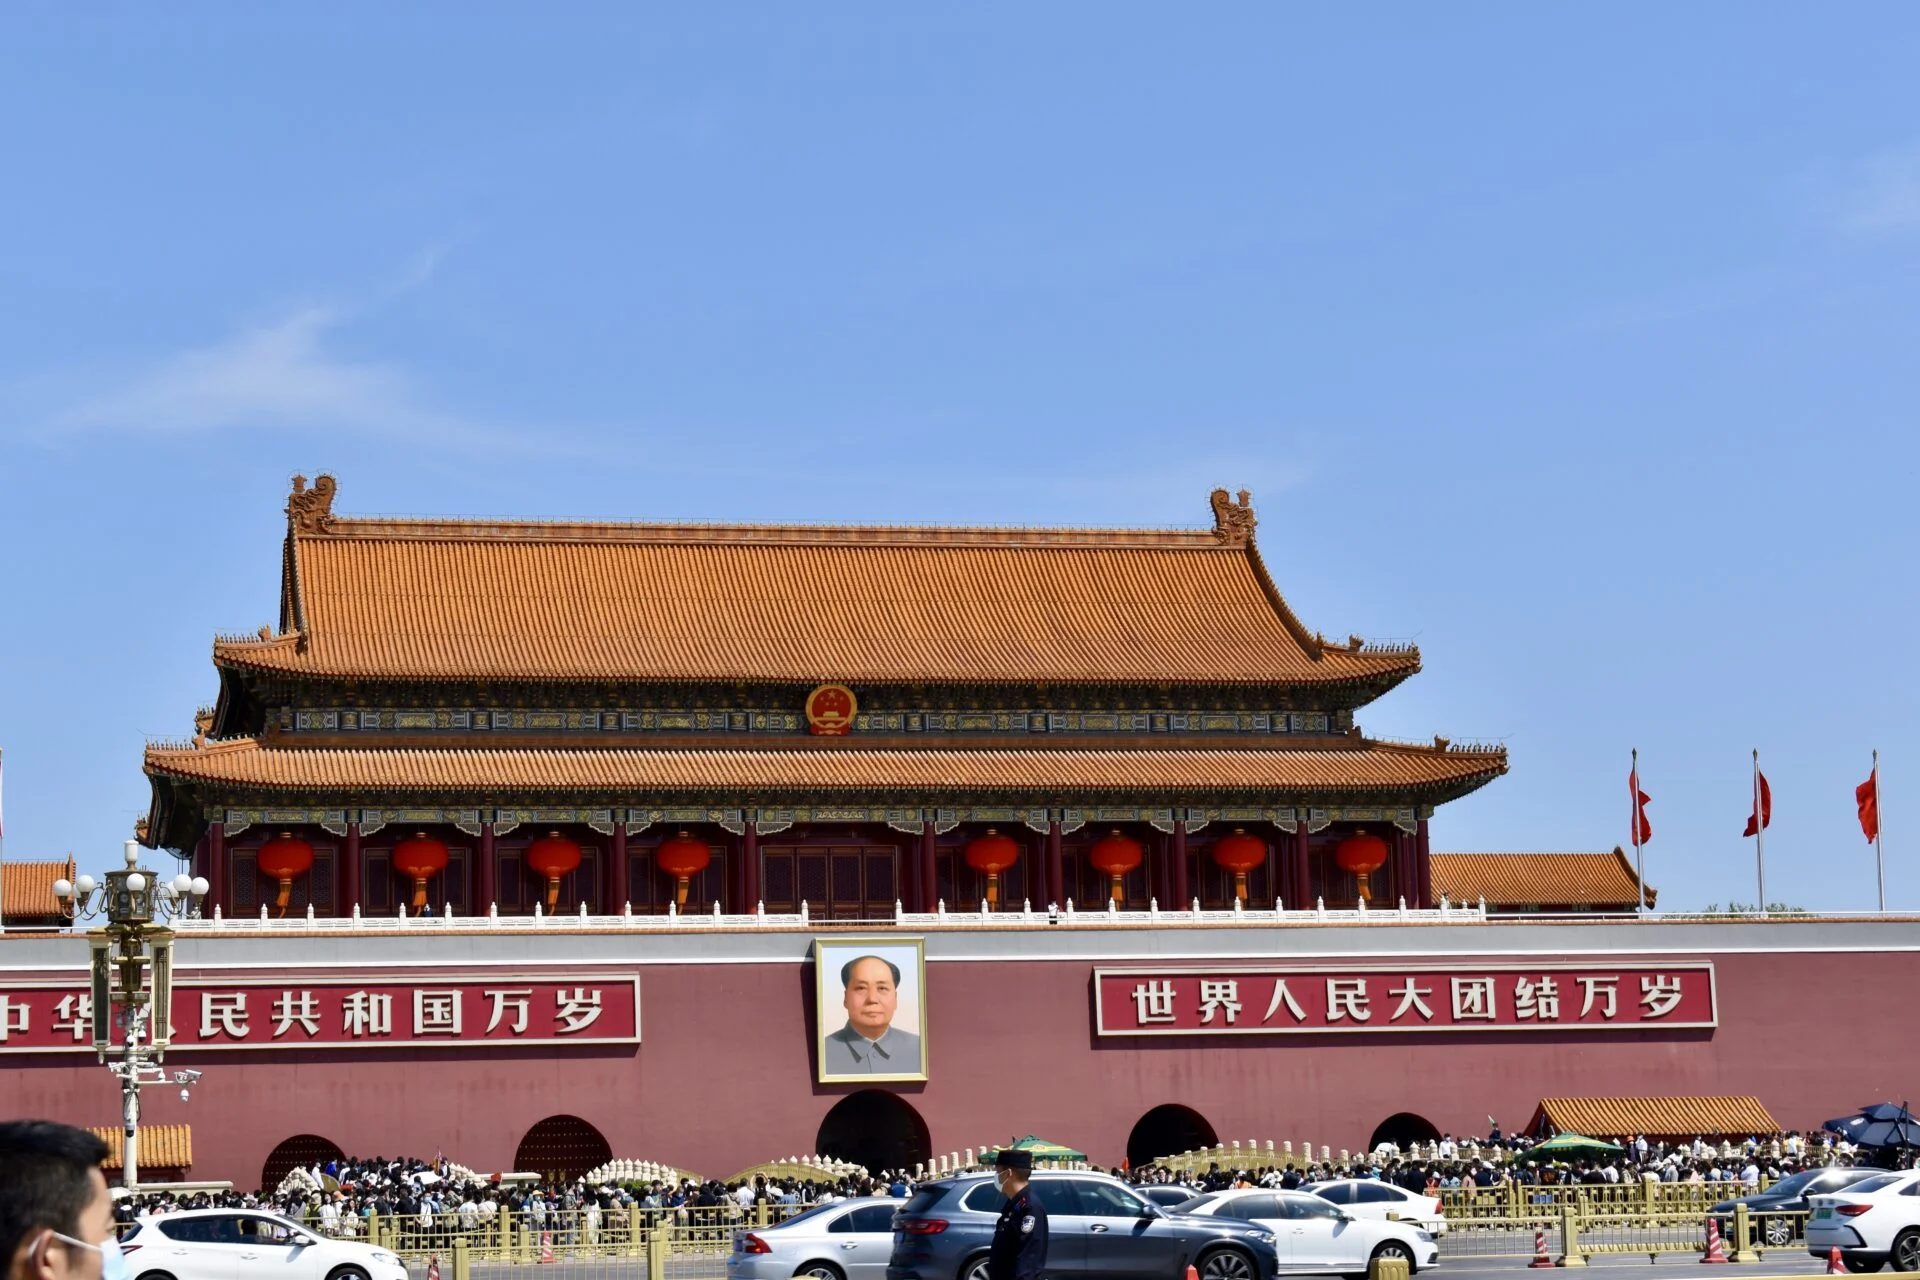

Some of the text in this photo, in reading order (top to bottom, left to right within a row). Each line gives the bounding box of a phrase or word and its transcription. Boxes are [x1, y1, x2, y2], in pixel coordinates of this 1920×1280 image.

[0, 987, 604, 1041] 中华民共和国万岁
[1132, 975, 1684, 1024] 世界人民大团结万岁
